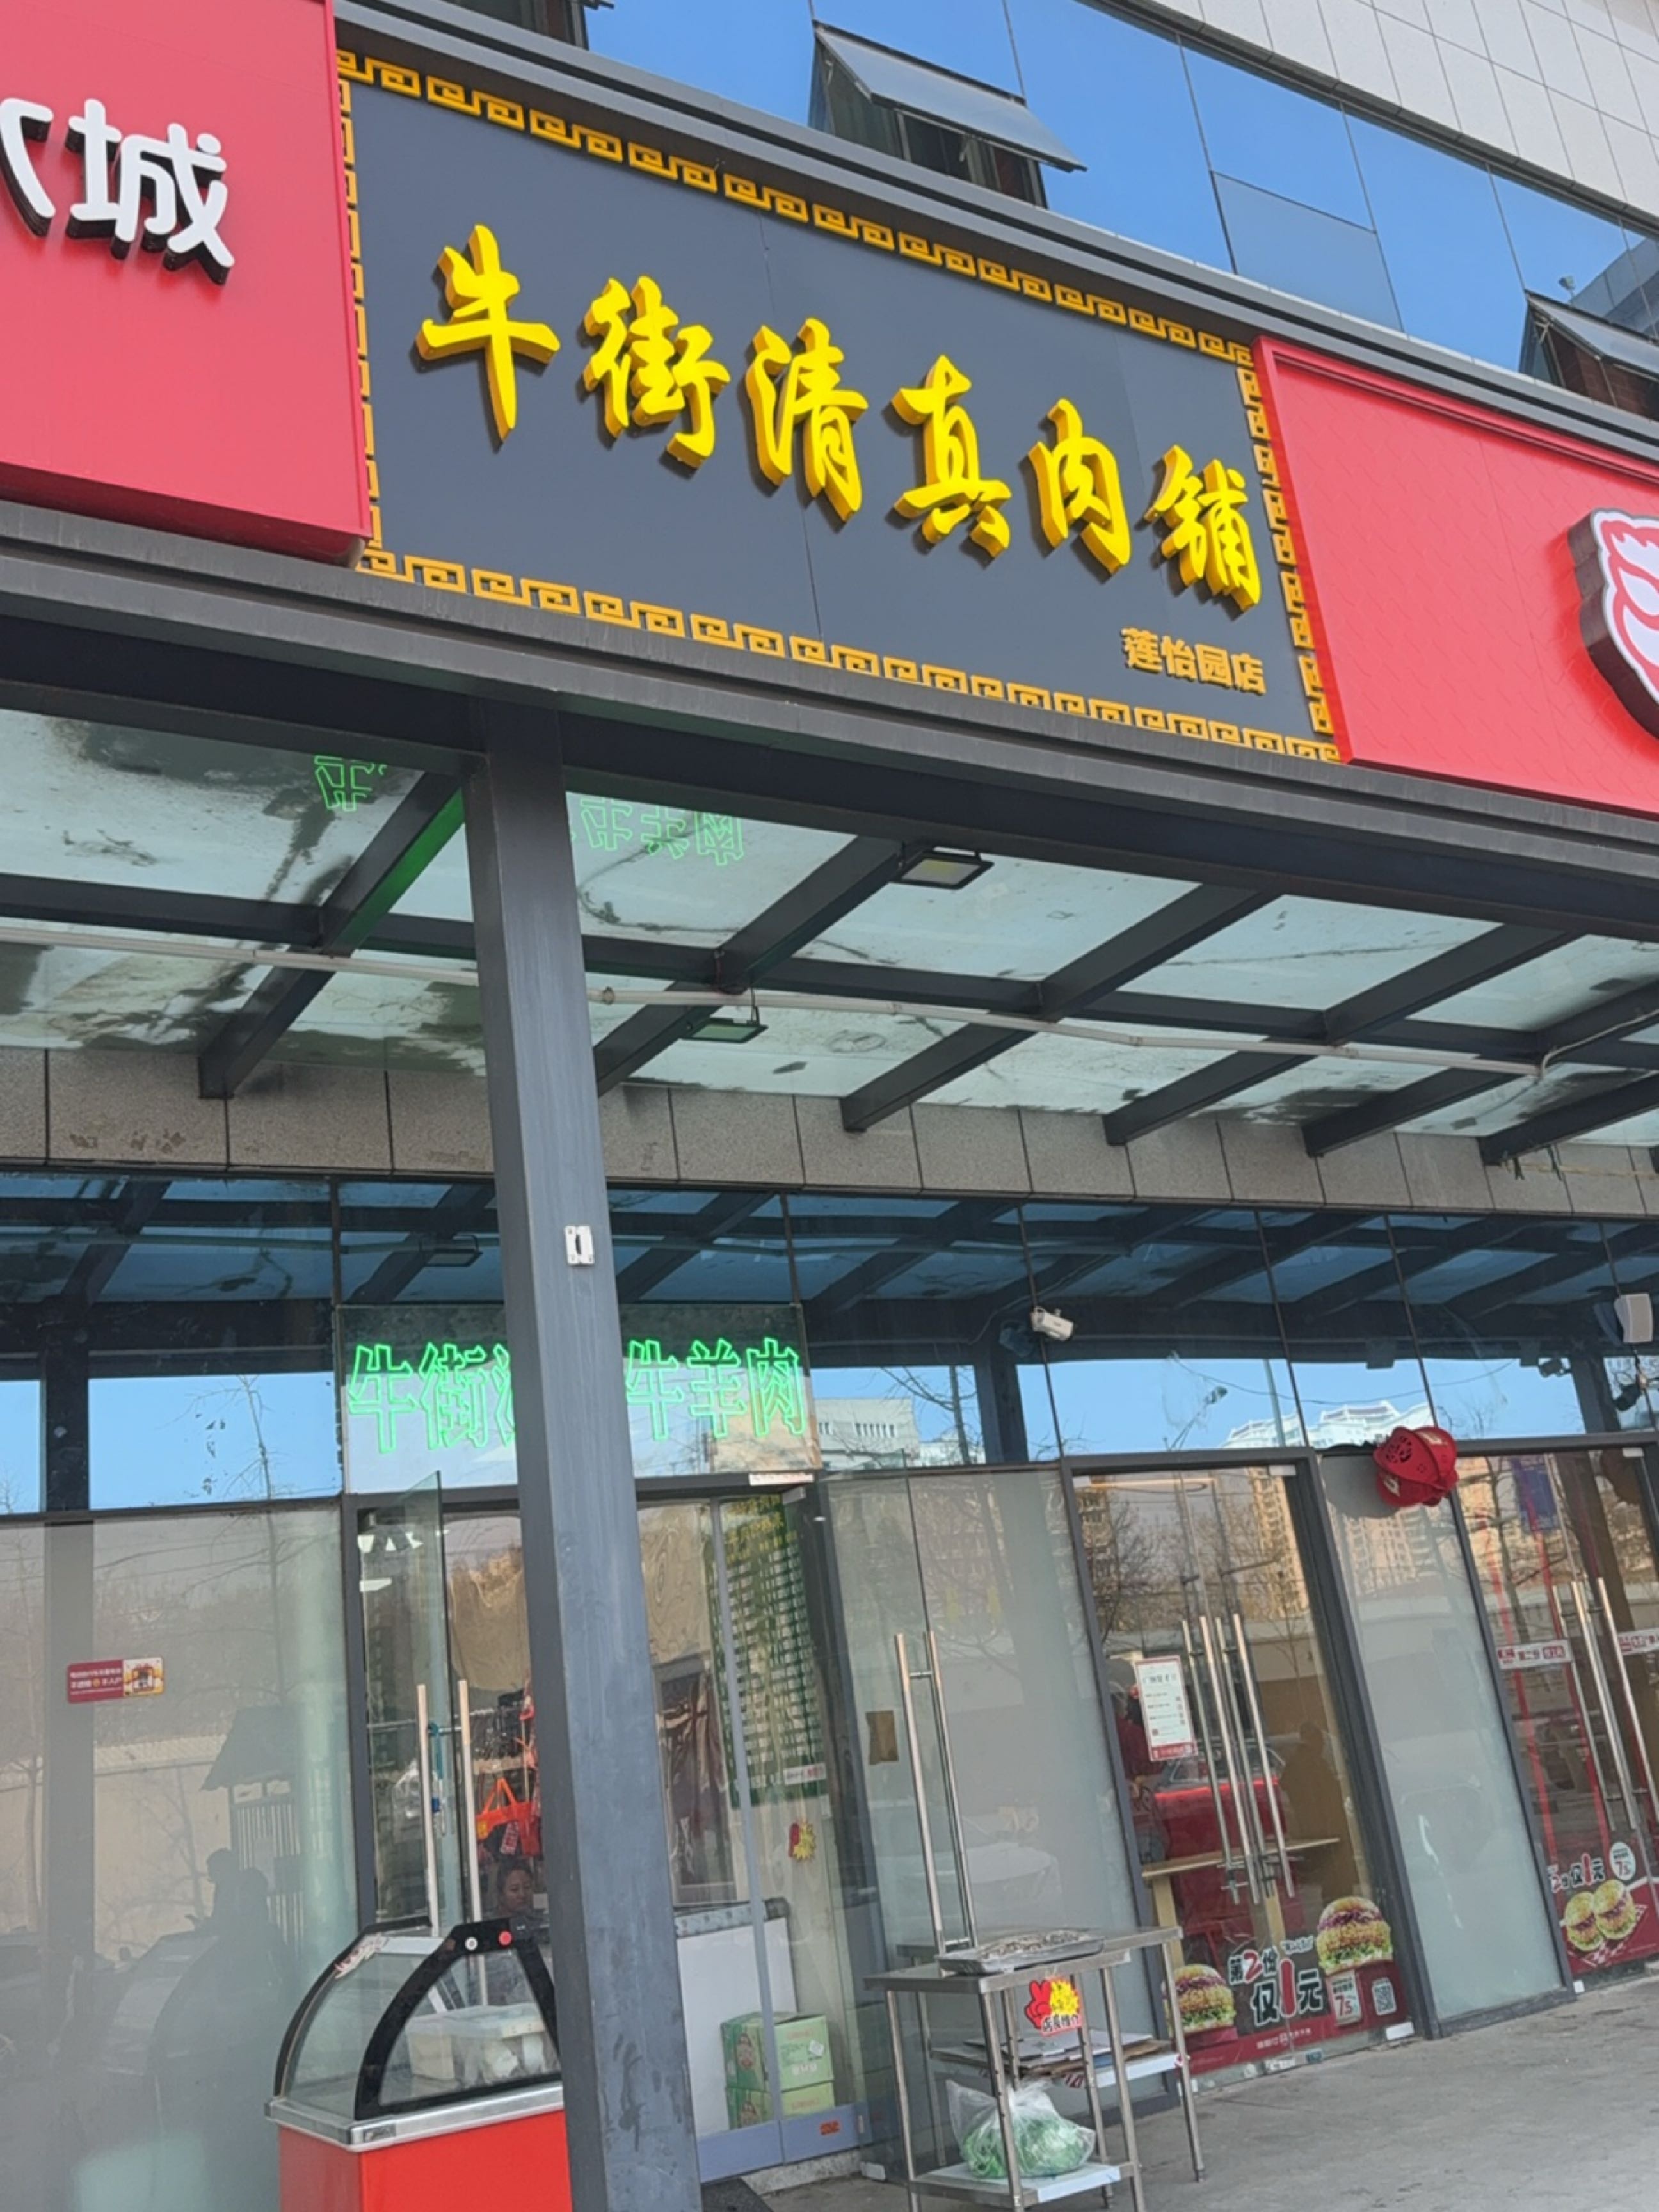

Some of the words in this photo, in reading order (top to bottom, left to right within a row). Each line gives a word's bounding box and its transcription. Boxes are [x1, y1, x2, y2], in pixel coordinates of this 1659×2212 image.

[1121, 627, 1266, 696] 莲怡园店
[348, 1337, 807, 1453] 牛街牛羊肉
